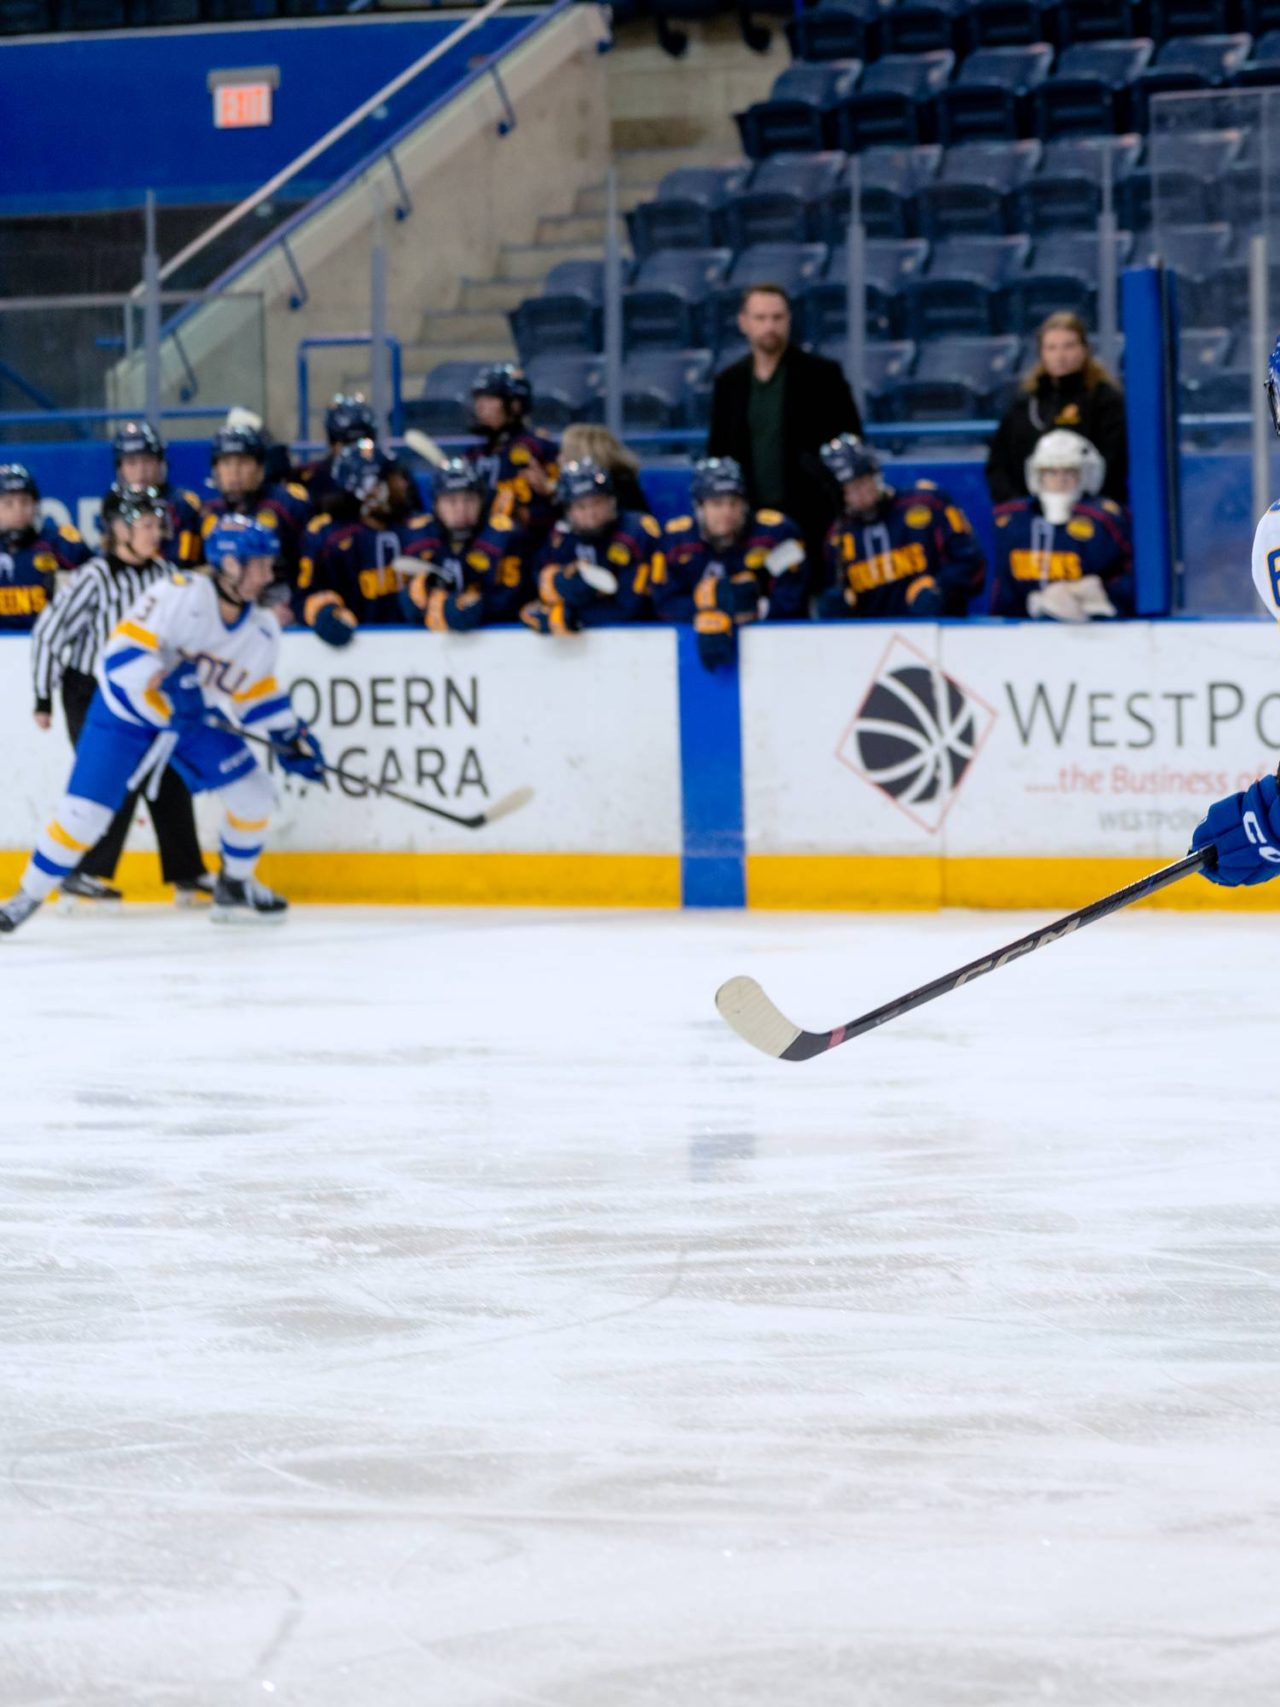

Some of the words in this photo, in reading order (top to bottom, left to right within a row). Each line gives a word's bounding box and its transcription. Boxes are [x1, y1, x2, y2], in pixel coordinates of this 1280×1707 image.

[287, 676, 479, 728] ODERN
[268, 745, 490, 799] GARA
[1110, 766, 1229, 794] Business
